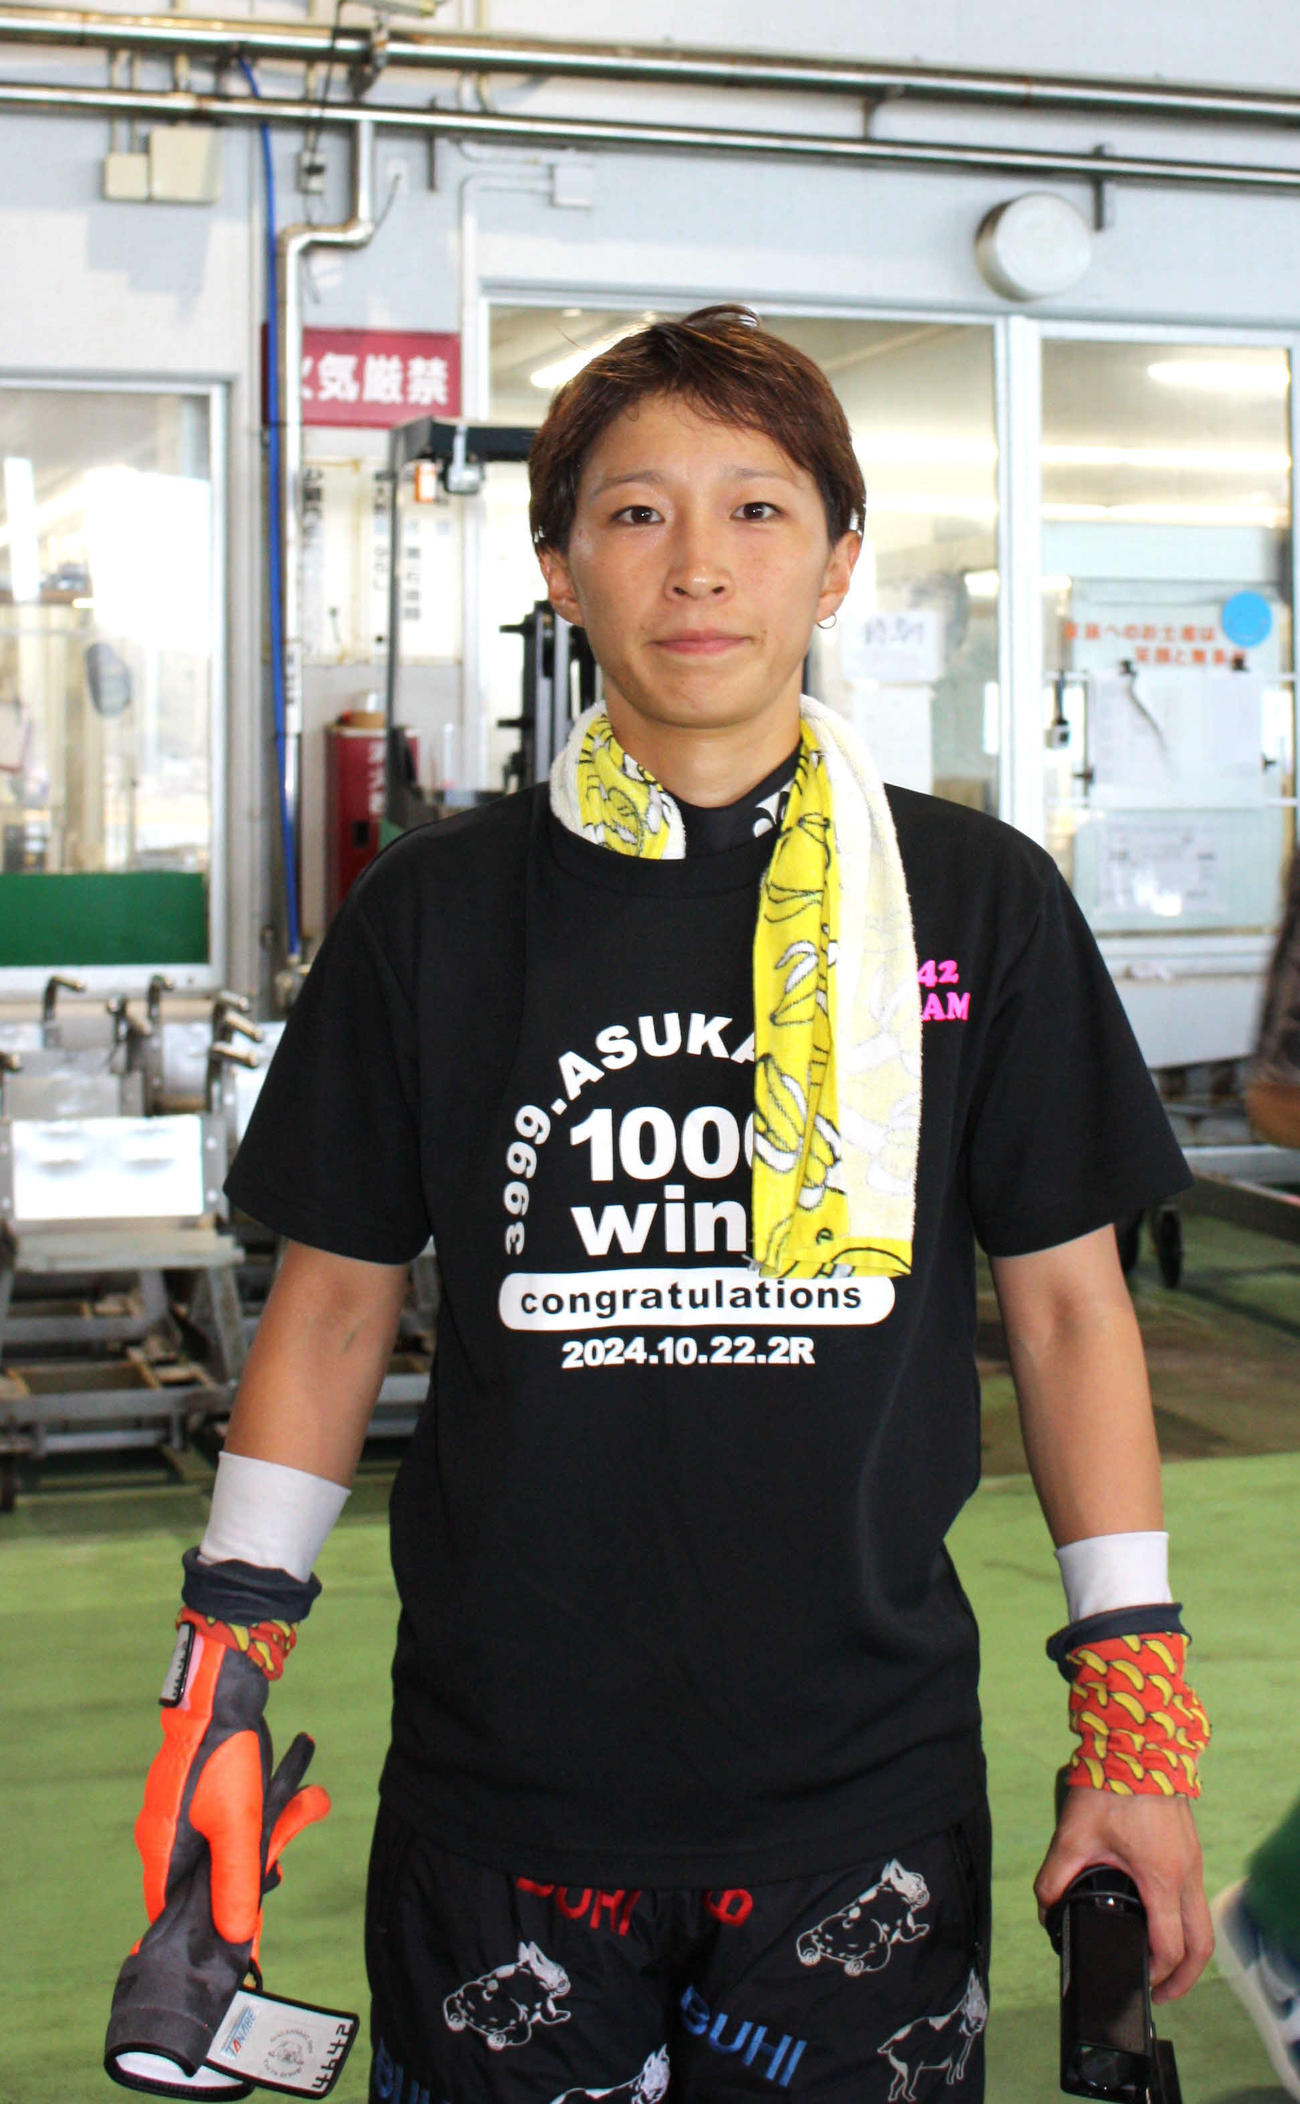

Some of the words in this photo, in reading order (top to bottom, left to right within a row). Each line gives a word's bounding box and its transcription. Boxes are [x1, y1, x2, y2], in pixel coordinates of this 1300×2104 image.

[917, 959, 960, 988] 42
[921, 991, 971, 1022] AM
[569, 1105, 755, 1183] 100
[569, 1184, 748, 1257] win
[519, 1280, 864, 1319] congratulations
[560, 1335, 816, 1370] 2024.10.22.2R
[516, 1876, 642, 1937] UHI
[680, 1984, 807, 2088] BUHI
